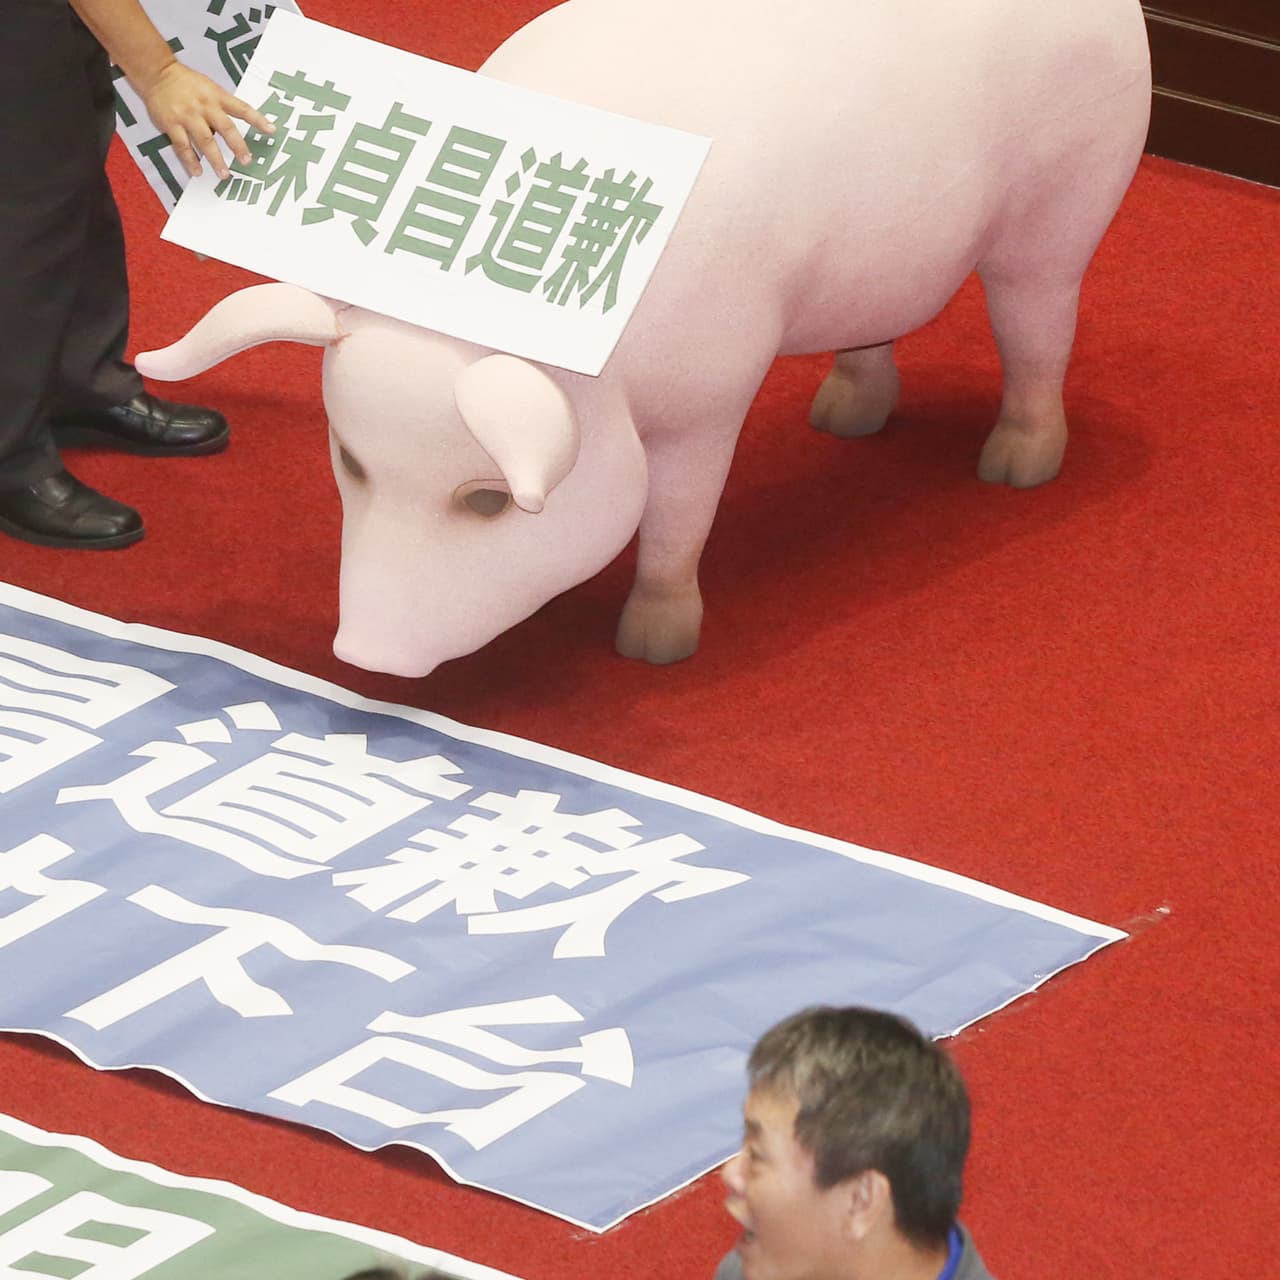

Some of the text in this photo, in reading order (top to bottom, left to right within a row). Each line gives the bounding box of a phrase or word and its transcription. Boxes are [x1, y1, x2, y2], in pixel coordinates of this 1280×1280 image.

[214, 70, 664, 315] 蘇貞昌道歉
